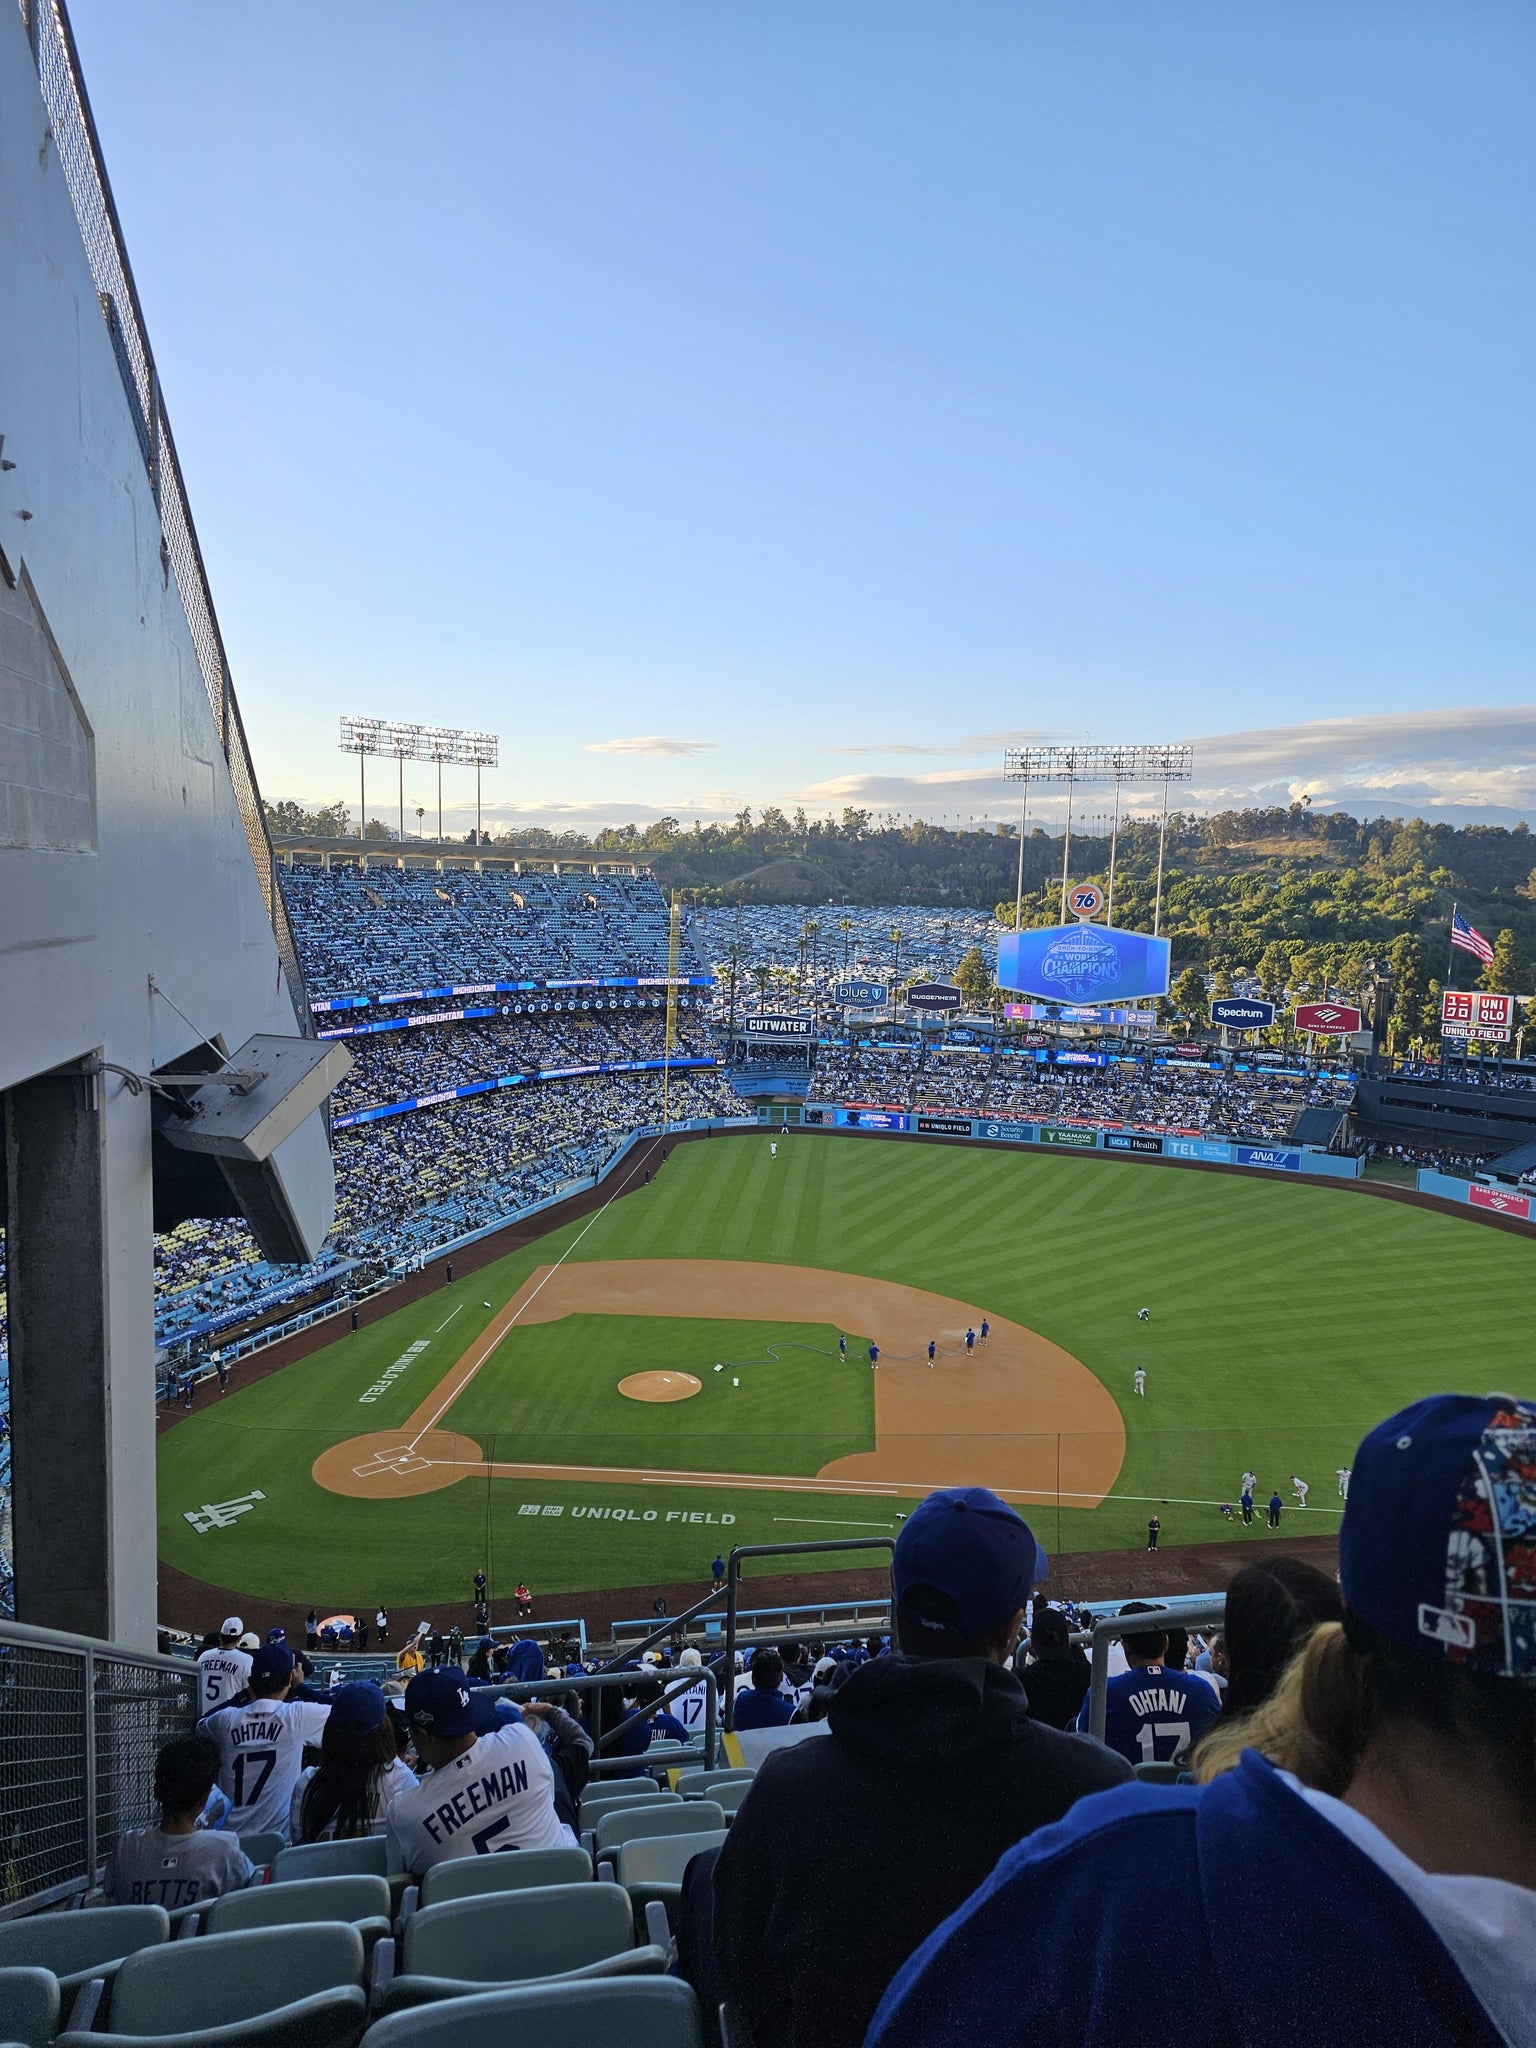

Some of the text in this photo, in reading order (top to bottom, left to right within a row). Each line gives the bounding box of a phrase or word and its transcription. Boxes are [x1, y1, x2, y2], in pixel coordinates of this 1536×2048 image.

[1074, 893, 1095, 909] 76
[1065, 953, 1098, 961] WORLD
[1044, 959, 1118, 979] CHAMPIONS
[637, 978, 664, 986] SHOHEI
[452, 985, 475, 995] SHOHEI
[840, 986, 868, 998] blue
[1482, 999, 1503, 1010] UNI
[1217, 1006, 1263, 1018] Spectrum
[1481, 1010, 1504, 1021] QLO
[408, 1014, 436, 1026] SHOHEI
[749, 1020, 807, 1032] CUTWATER
[1026, 1035, 1043, 1043] JINRO
[1445, 1026, 1504, 1039] UNIQLO FIELD
[1177, 1046, 1200, 1054] Yakult
[1000, 1125, 1024, 1134] Security
[1000, 1131, 1021, 1140] Benefit
[1111, 1138, 1158, 1150] UCLA Health
[1171, 1142, 1198, 1156] TEL
[1203, 1150, 1229, 1158] ELECTRON
[1249, 1151, 1274, 1162] ANA
[1475, 1187, 1490, 1195] BANK
[1499, 1192, 1524, 1203] AMERICA
[358, 1353, 418, 1403] UNIQLO FIELD
[571, 1506, 736, 1525] UNIQLO FIELD
[201, 1658, 239, 1675] FREEMAN
[206, 1675, 222, 1701] 5
[457, 1687, 470, 1708] LA
[1128, 1688, 1187, 1717] OHTANI
[682, 1698, 704, 1725] 17
[231, 1721, 283, 1746] OHTANI
[1136, 1721, 1191, 1763] 17
[232, 1749, 277, 1807] 17
[422, 1759, 529, 1846] FREEMAN
[131, 1880, 200, 1905] BETTS
